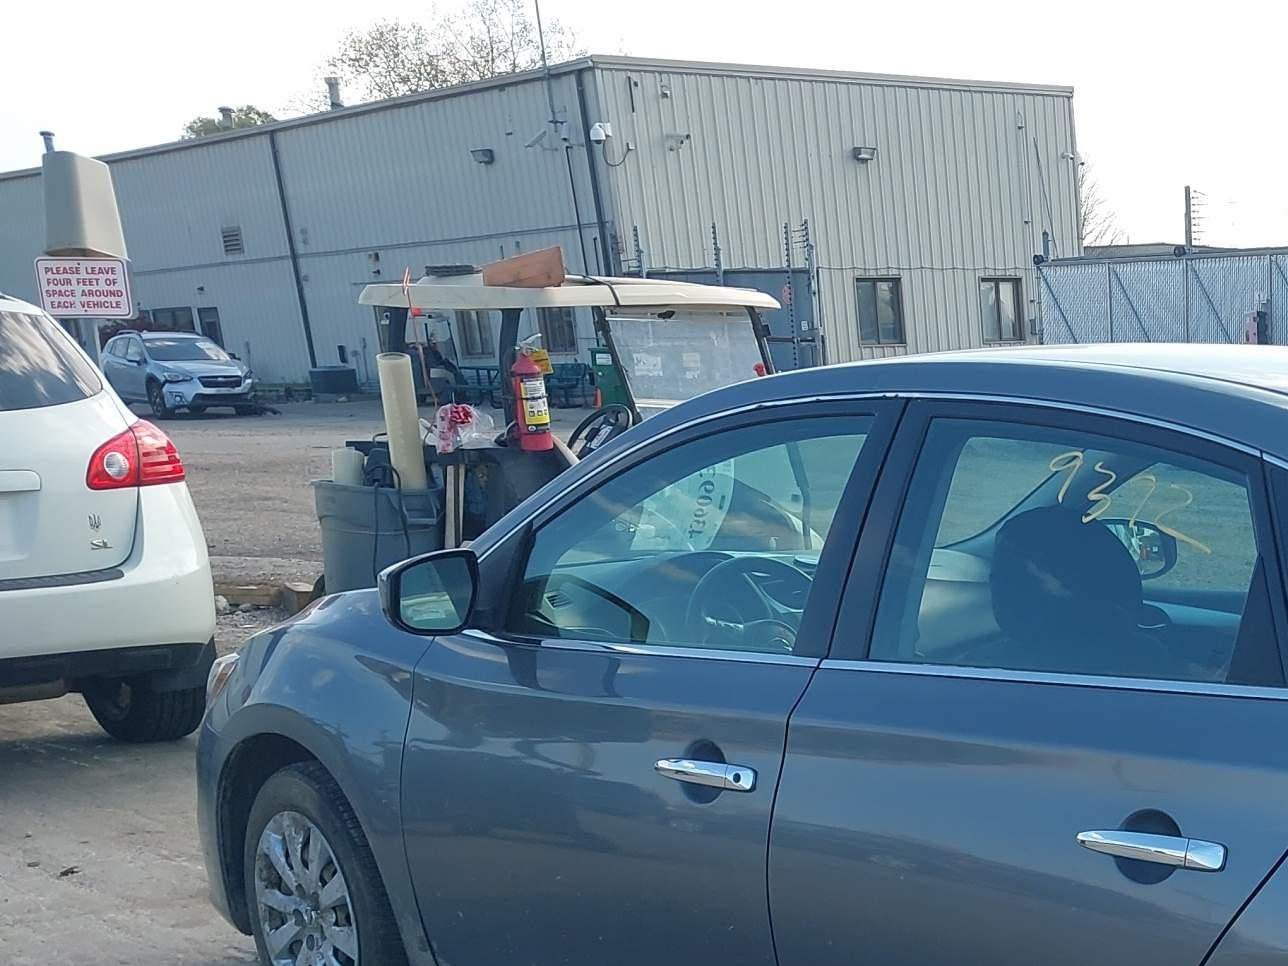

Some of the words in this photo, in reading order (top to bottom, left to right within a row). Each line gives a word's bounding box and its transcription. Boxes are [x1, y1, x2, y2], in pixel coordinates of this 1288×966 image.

[44, 266, 81, 275] PLEASE
[85, 266, 117, 275] LEAVE
[47, 278, 73, 287] FOUR
[76, 278, 100, 287] FEET
[104, 278, 118, 287] OF
[45, 289, 77, 298] SPACE
[80, 289, 123, 298] AROUND
[50, 300, 76, 310] EACH
[80, 300, 122, 310] VEHICLE
